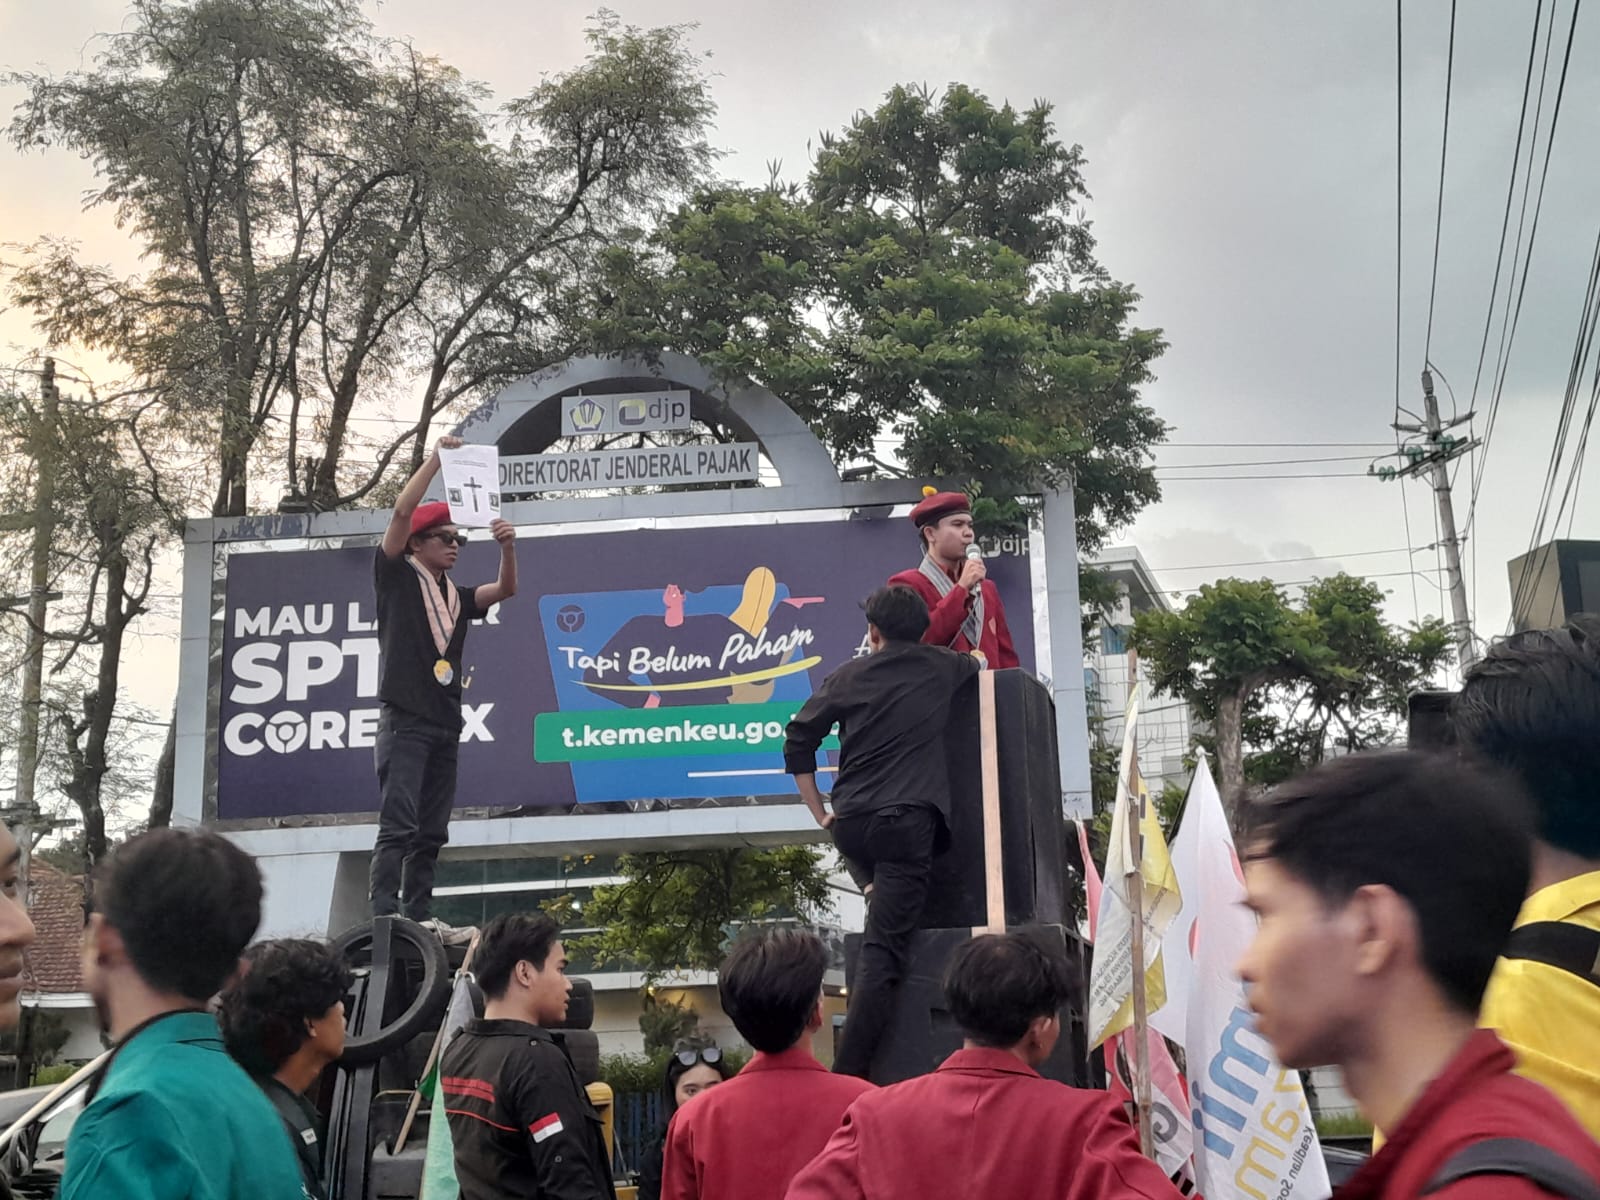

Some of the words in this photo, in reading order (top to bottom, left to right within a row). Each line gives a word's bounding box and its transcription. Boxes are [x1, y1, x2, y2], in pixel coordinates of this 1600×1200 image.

[648, 396, 685, 425] djp
[499, 457, 601, 486] DIREKTORAT
[605, 451, 692, 481] JENDERAL
[697, 448, 752, 476] PAJAK
[234, 603, 334, 638] MAU
[229, 637, 381, 705] SPT
[558, 646, 621, 678] Tapi
[628, 645, 712, 675] Belum
[718, 626, 815, 671] Paham
[223, 703, 495, 757] COREX
